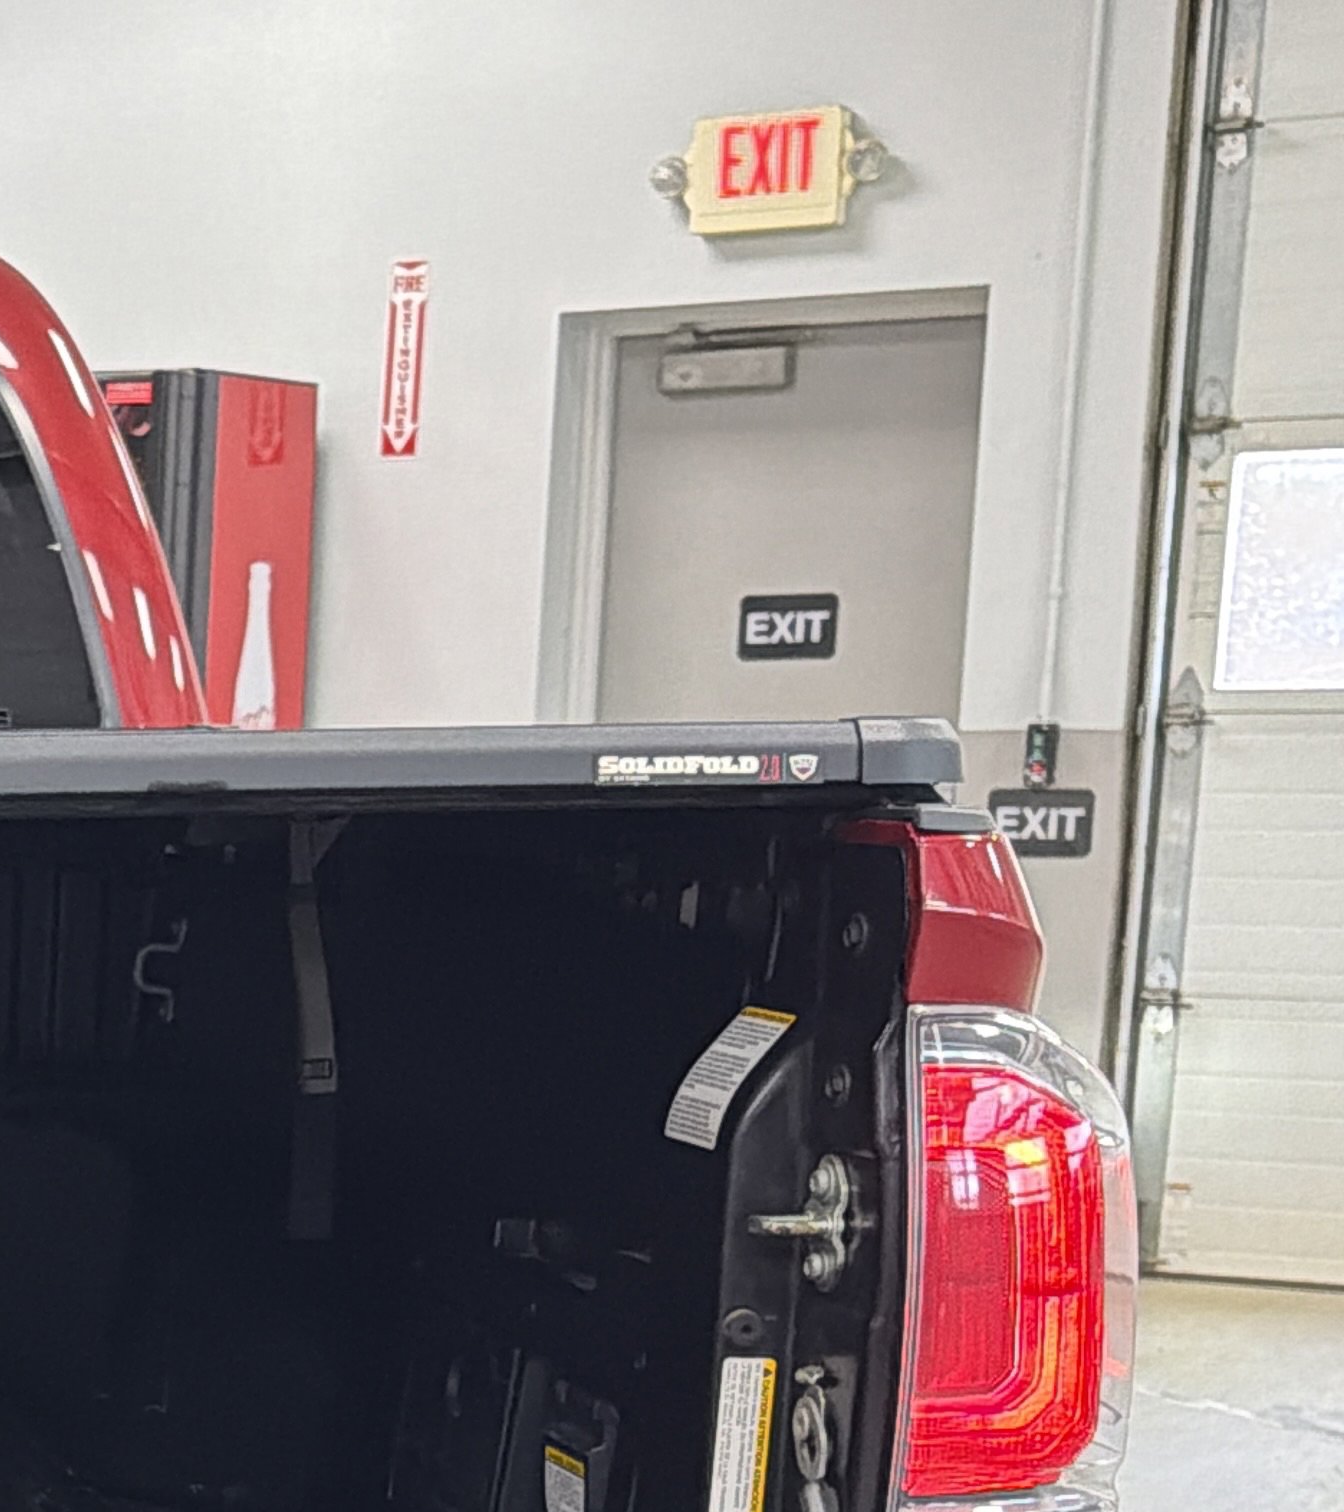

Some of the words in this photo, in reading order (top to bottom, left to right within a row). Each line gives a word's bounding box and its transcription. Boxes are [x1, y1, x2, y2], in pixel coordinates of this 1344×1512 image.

[718, 117, 821, 198] EXIT
[393, 275, 426, 293] FIRE
[745, 610, 831, 645] EXIT
[996, 806, 1087, 840] EXIT
[759, 1379, 772, 1419] CAUTION
